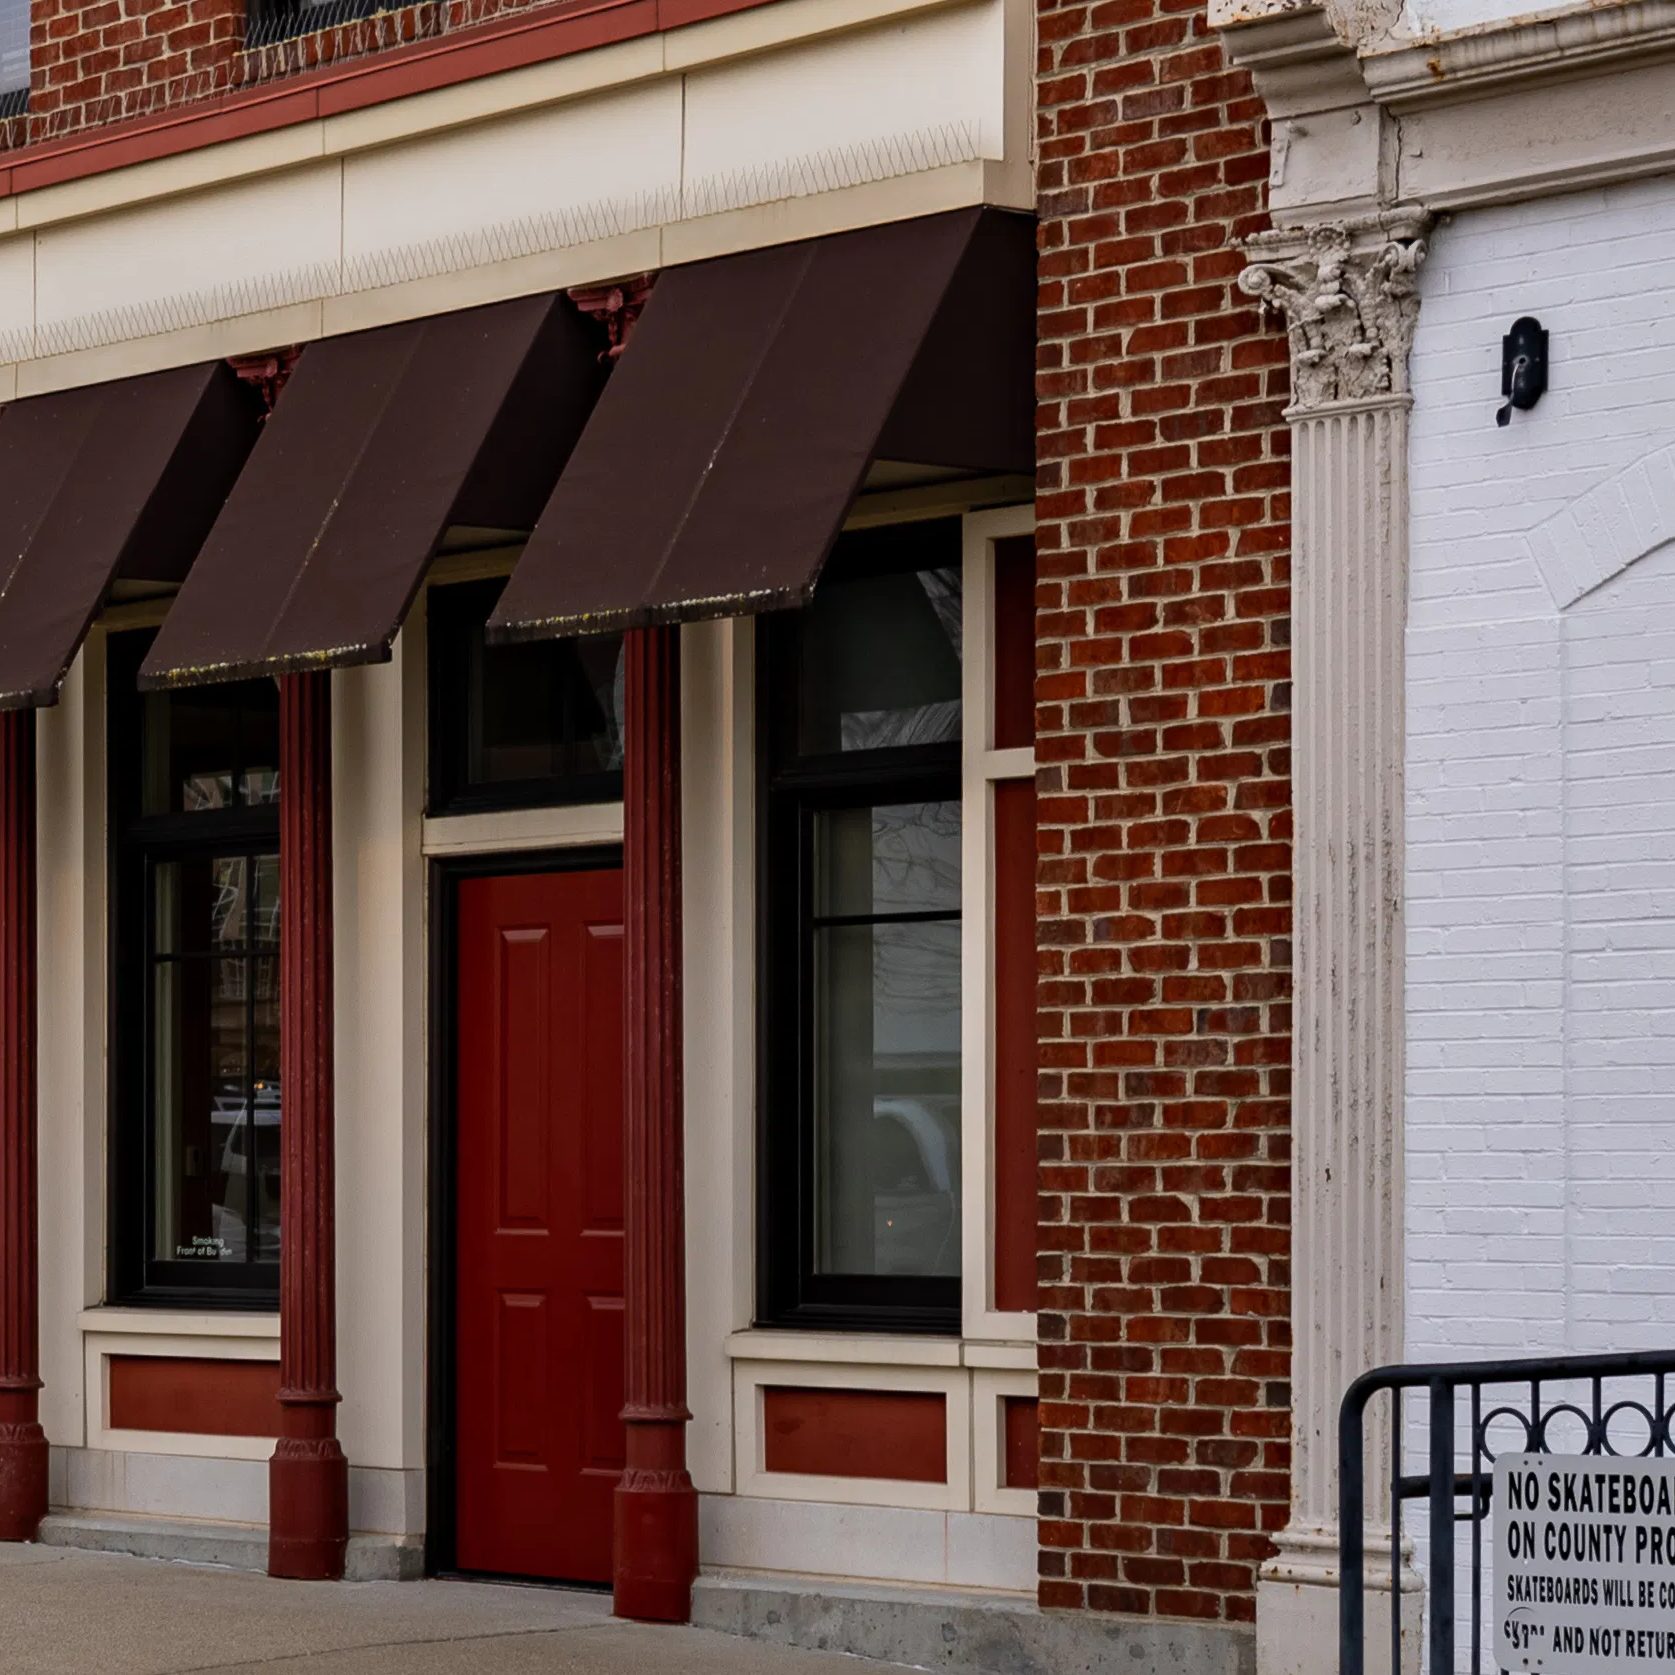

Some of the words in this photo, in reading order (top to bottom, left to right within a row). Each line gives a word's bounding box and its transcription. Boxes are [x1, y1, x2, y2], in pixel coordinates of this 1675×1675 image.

[177, 1245, 196, 1256] Front
[1507, 1471, 1540, 1511] NO
[1547, 1471, 1675, 1515] SKATEBOA
[1507, 1520, 1536, 1560] ON
[1544, 1521, 1627, 1564] COUNTY
[1635, 1525, 1675, 1566] PRO
[1507, 1574, 1599, 1606] SKATEBOARDS
[1602, 1578, 1634, 1607] WILL
[1638, 1580, 1655, 1609] BE
[1659, 1581, 1675, 1610] CO
[1553, 1626, 1585, 1654] AND
[1589, 1628, 1621, 1658] NOT
[1626, 1629, 1675, 1660] RETUR
